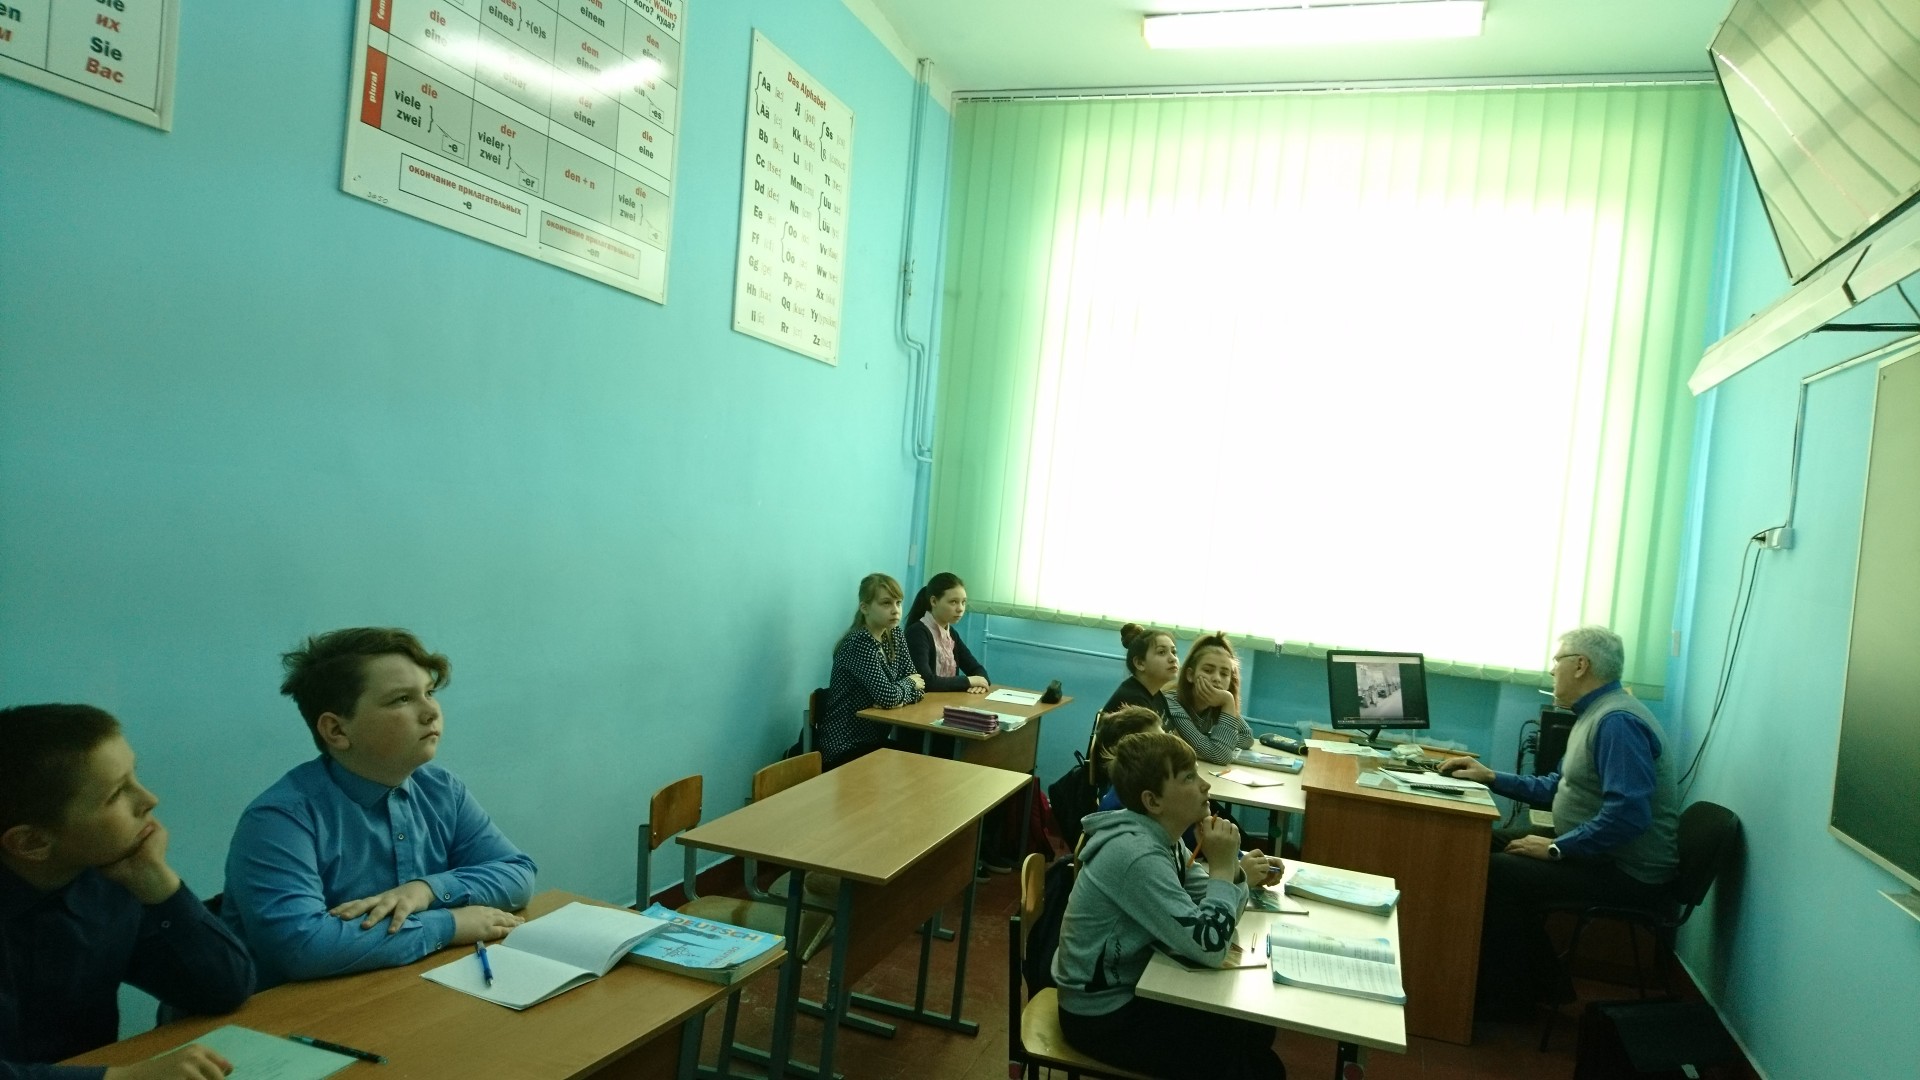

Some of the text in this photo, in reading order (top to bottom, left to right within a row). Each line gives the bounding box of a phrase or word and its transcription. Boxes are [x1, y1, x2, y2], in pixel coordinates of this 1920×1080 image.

[500, 0, 516, 10] es
[653, 0, 678, 22] Wohin?
[96, 13, 120, 32] их
[429, 10, 447, 26] die
[488, 5, 514, 27] eines
[580, 6, 605, 28] einem
[656, 14, 676, 31] куда?
[90, 36, 122, 61] Sie
[646, 34, 660, 49] den
[581, 41, 599, 58] dem
[86, 57, 124, 83] Вас
[369, 71, 378, 104] plural
[421, 83, 438, 99] die
[762, 77, 771, 92] Aa
[787, 71, 827, 111] Das Alphabet
[394, 90, 421, 110] viele
[795, 102, 801, 116] Jj
[396, 109, 421, 128] zwei
[573, 110, 596, 127] einer
[500, 124, 517, 139] der
[641, 130, 653, 143] die
[759, 128, 769, 144] Bb
[792, 126, 802, 142] Kk
[825, 127, 834, 140] Ss
[448, 142, 458, 153] -e
[477, 131, 505, 151] vieler
[479, 148, 501, 165] zwei
[638, 145, 654, 159] eine
[756, 153, 766, 168] Cc
[522, 176, 535, 188] -er
[564, 168, 581, 184] den
[790, 174, 803, 192] Mm
[824, 173, 831, 186] Tt
[408, 164, 522, 216] окончание прилагательных
[635, 187, 647, 199] die
[754, 179, 765, 195] Dd
[462, 200, 472, 210] -e
[618, 193, 636, 209] viele
[789, 200, 799, 214] Nn
[823, 196, 832, 210] Uu
[619, 208, 636, 222] zwei
[753, 205, 763, 219] Ee
[751, 231, 760, 244] Ff
[788, 225, 798, 239] Oo
[820, 243, 827, 255] Vv
[748, 255, 759, 271] Gg
[816, 264, 827, 278] Ww
[783, 272, 792, 286] Pp
[746, 282, 757, 296] Hh
[816, 288, 824, 300] Xx
[781, 296, 791, 311] Qq
[811, 309, 819, 322] Yy
[781, 322, 789, 334] Rr
[813, 335, 821, 346] Zz
[672, 917, 761, 942] DEUTSCH
